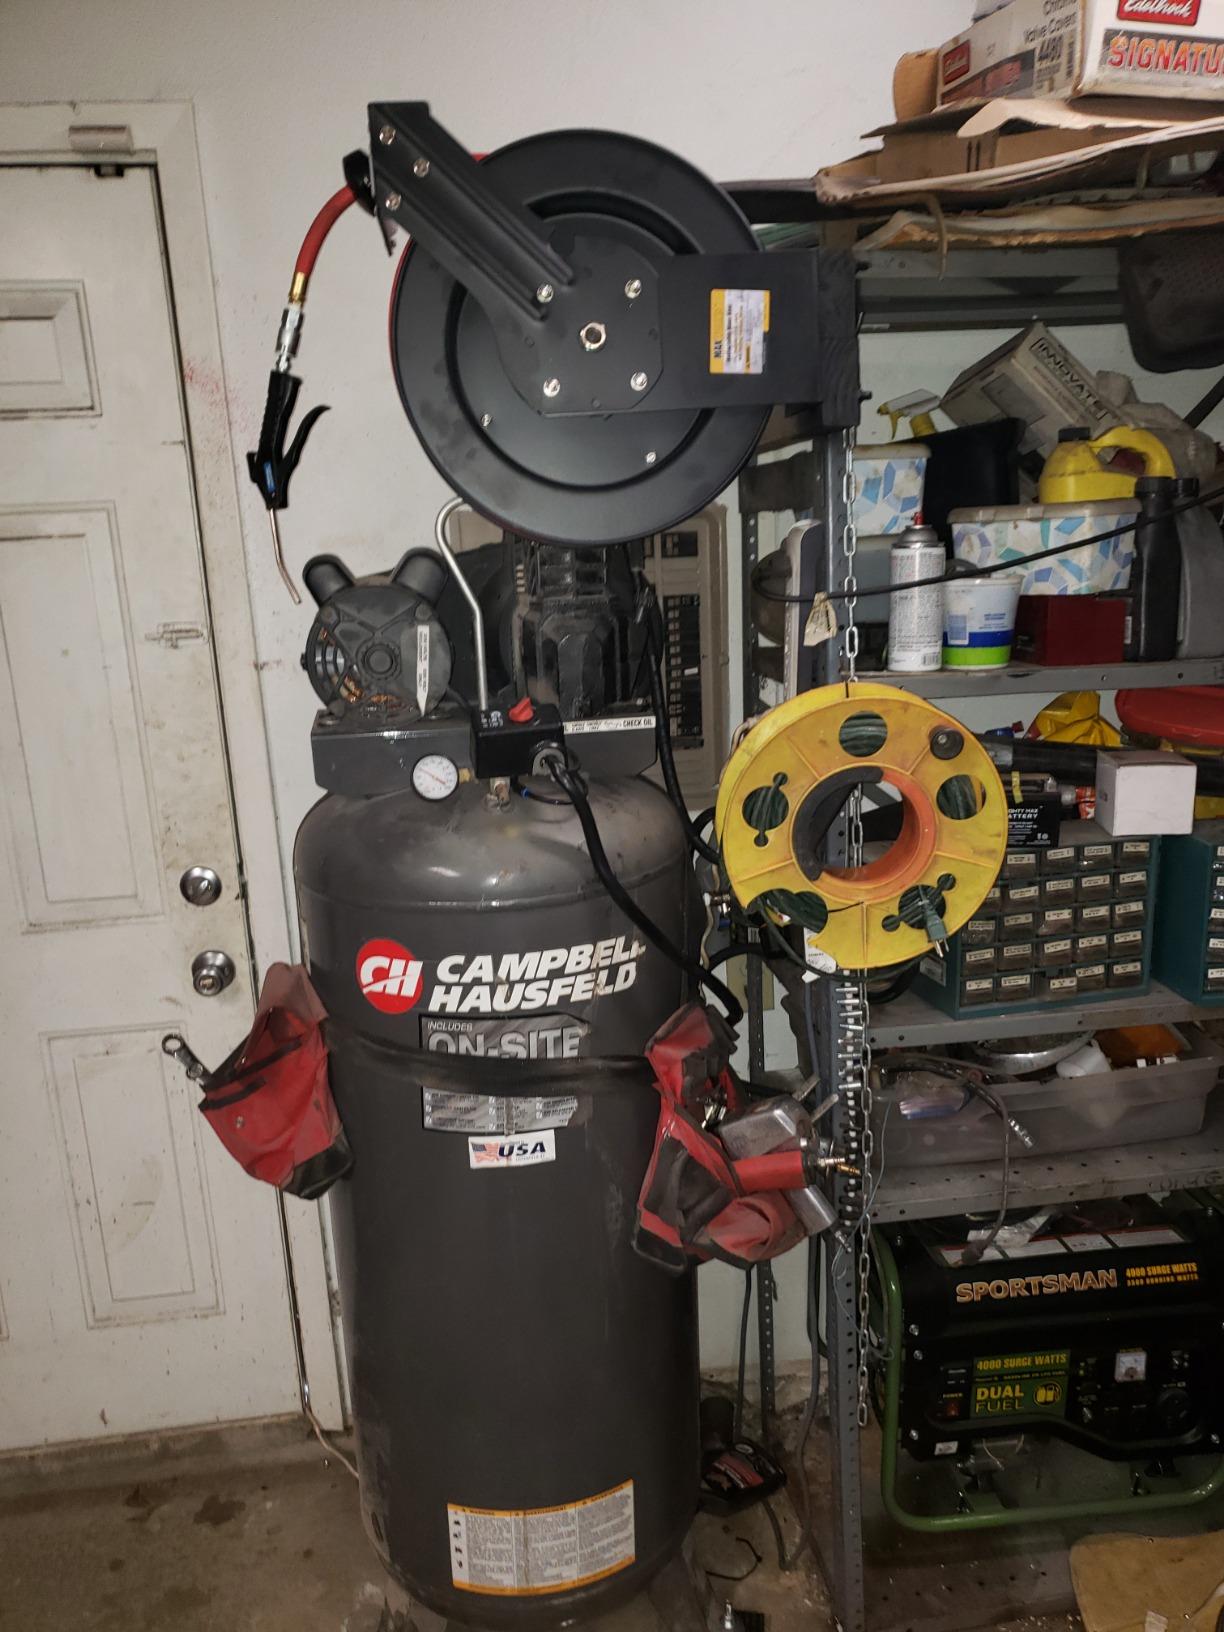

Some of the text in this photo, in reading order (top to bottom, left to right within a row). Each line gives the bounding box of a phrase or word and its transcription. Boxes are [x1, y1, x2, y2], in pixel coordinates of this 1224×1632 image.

[1106, 34, 1224, 76] SIGNATU
[622, 719, 642, 728] CHECK
[643, 717, 654, 726] OIL
[436, 935, 647, 984] CAMPBELL
[360, 955, 424, 998] CH
[427, 961, 638, 1013] HAUSFELD
[427, 1021, 473, 1032] INCLUDES
[498, 1141, 546, 1157] USA
[1126, 1262, 1198, 1278] 4000 SURGE WATTS
[956, 1268, 1118, 1303] SPORTSMAN
[976, 1353, 1067, 1371] 4000 SURGE WATTS
[976, 1384, 1025, 1401] DUAL
[976, 1398, 1025, 1414] FUEL
